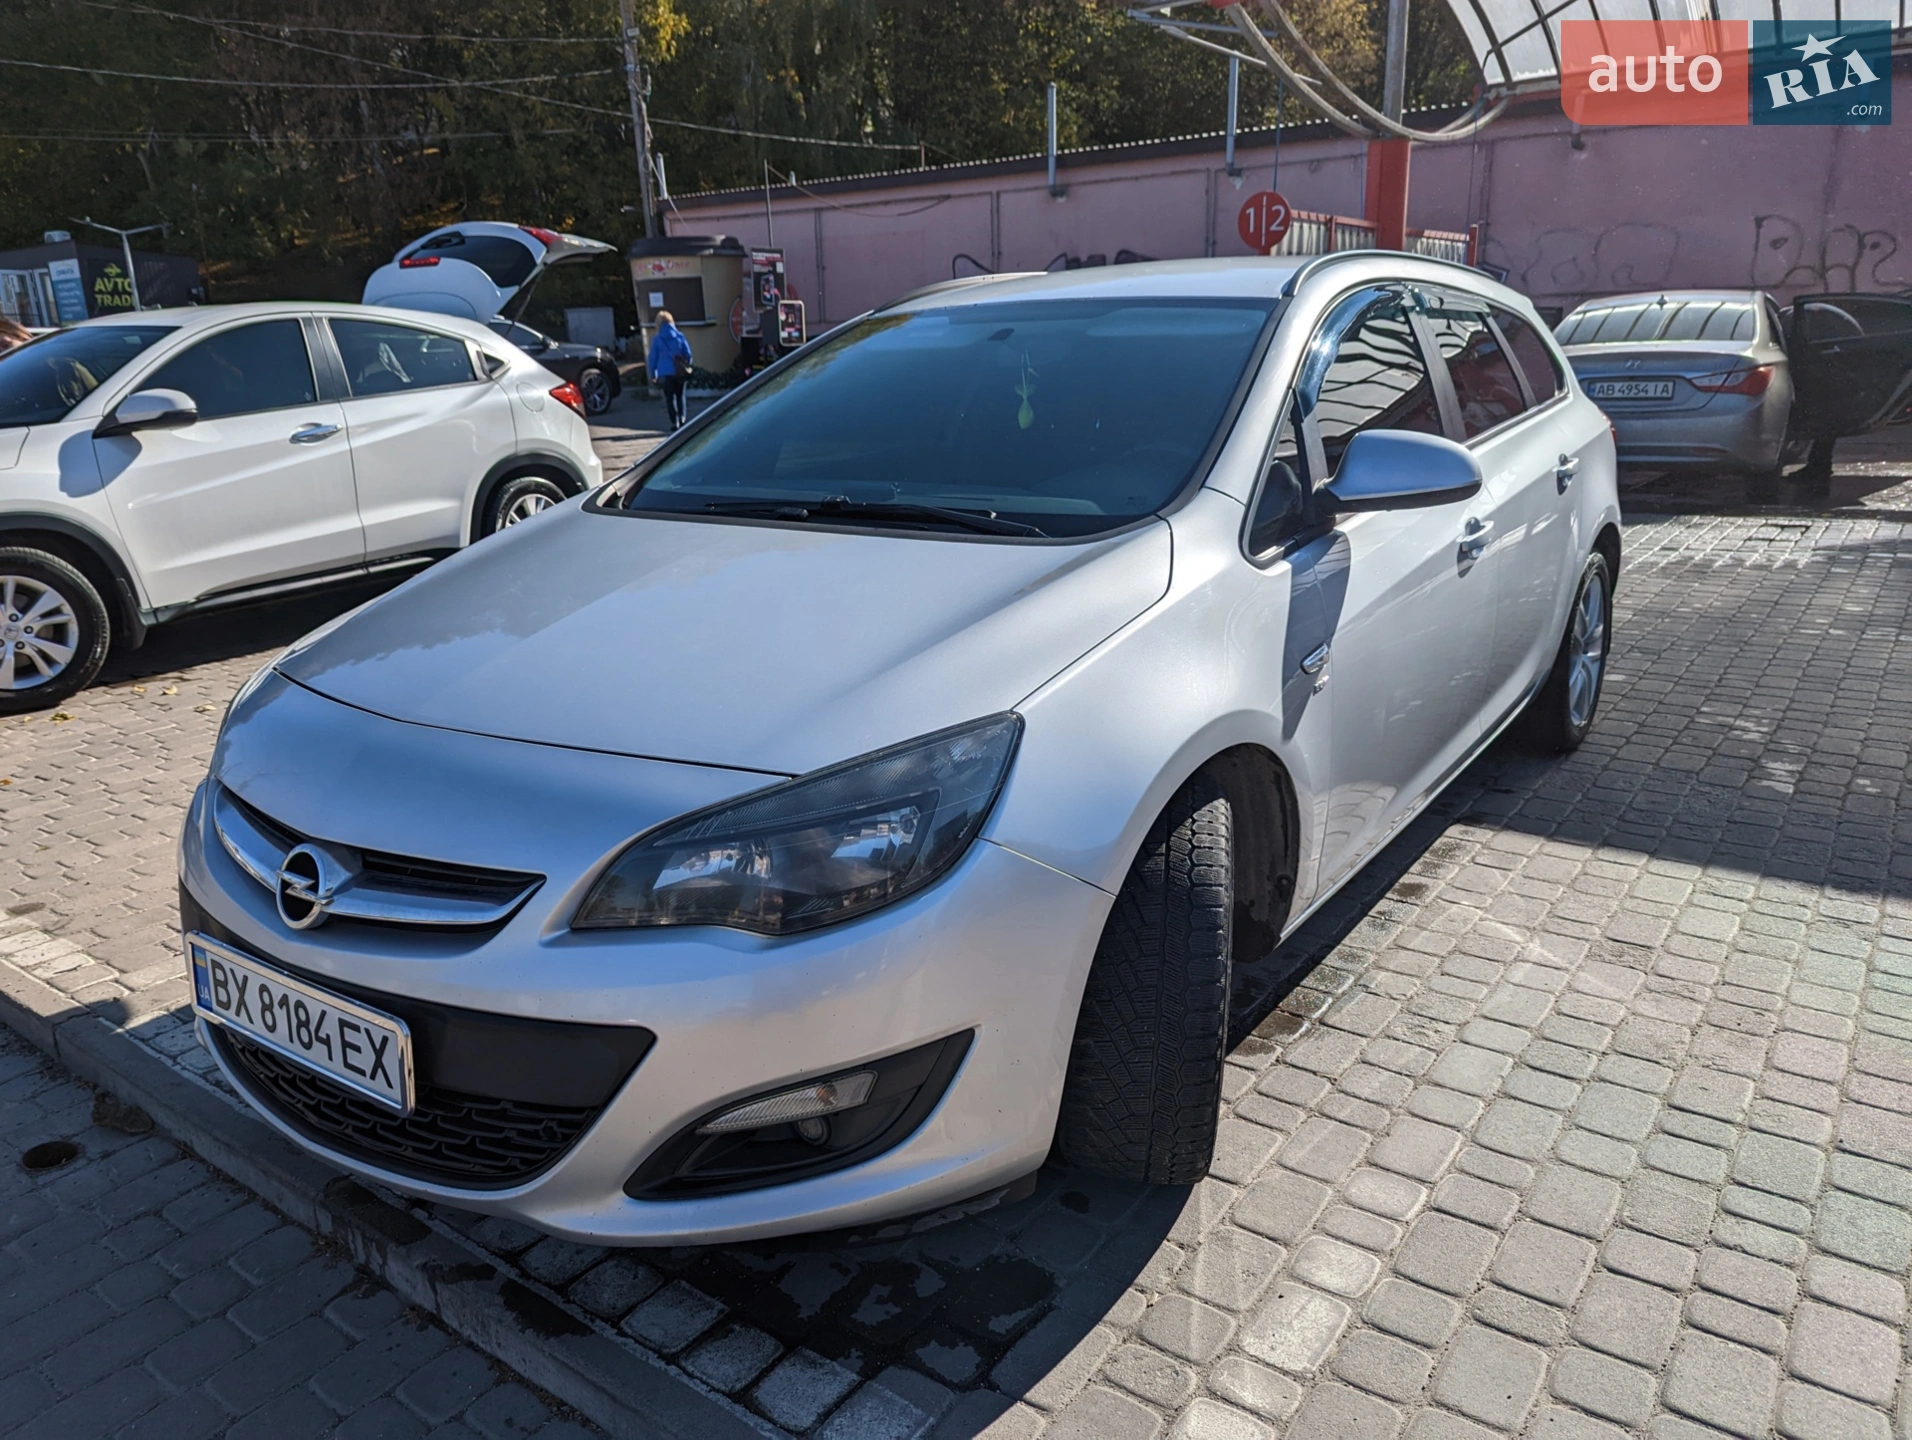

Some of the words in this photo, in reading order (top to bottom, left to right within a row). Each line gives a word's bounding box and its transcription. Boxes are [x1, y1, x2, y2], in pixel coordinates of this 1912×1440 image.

[1597, 383, 1615, 395] AB
[1618, 382, 1648, 395] 4954
[210, 958, 254, 1026] BX
[258, 983, 334, 1062] 8184
[338, 1017, 394, 1090] EX
